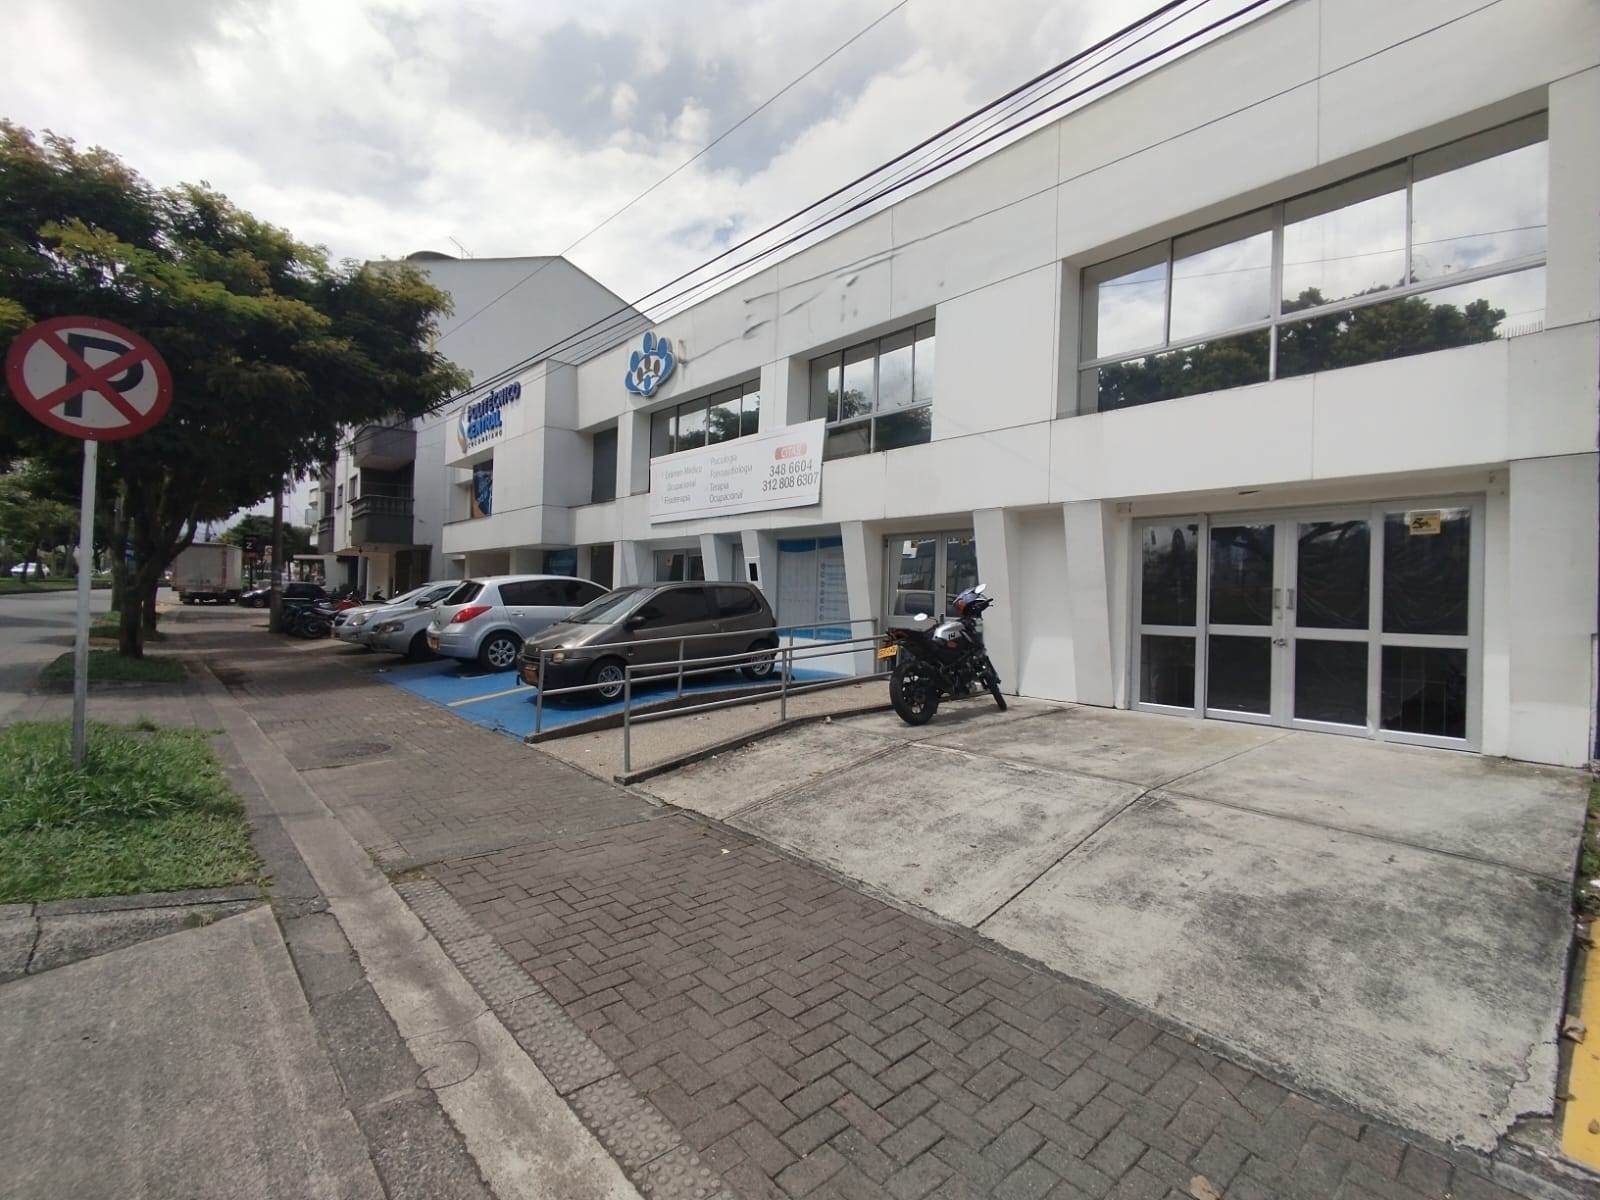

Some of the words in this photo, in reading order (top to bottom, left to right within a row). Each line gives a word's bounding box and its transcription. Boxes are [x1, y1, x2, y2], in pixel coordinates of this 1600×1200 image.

[64, 332, 144, 418] P
[467, 381, 522, 423] POLITÉCNICO
[467, 410, 503, 440] CENTRAL
[468, 430, 503, 449] COLOMBIANO
[769, 463, 786, 478] 348
[788, 459, 812, 474] 6604
[762, 478, 778, 492] 312
[779, 475, 795, 490] 808
[796, 471, 820, 487] 6307
[709, 489, 744, 504] Ocupacional
